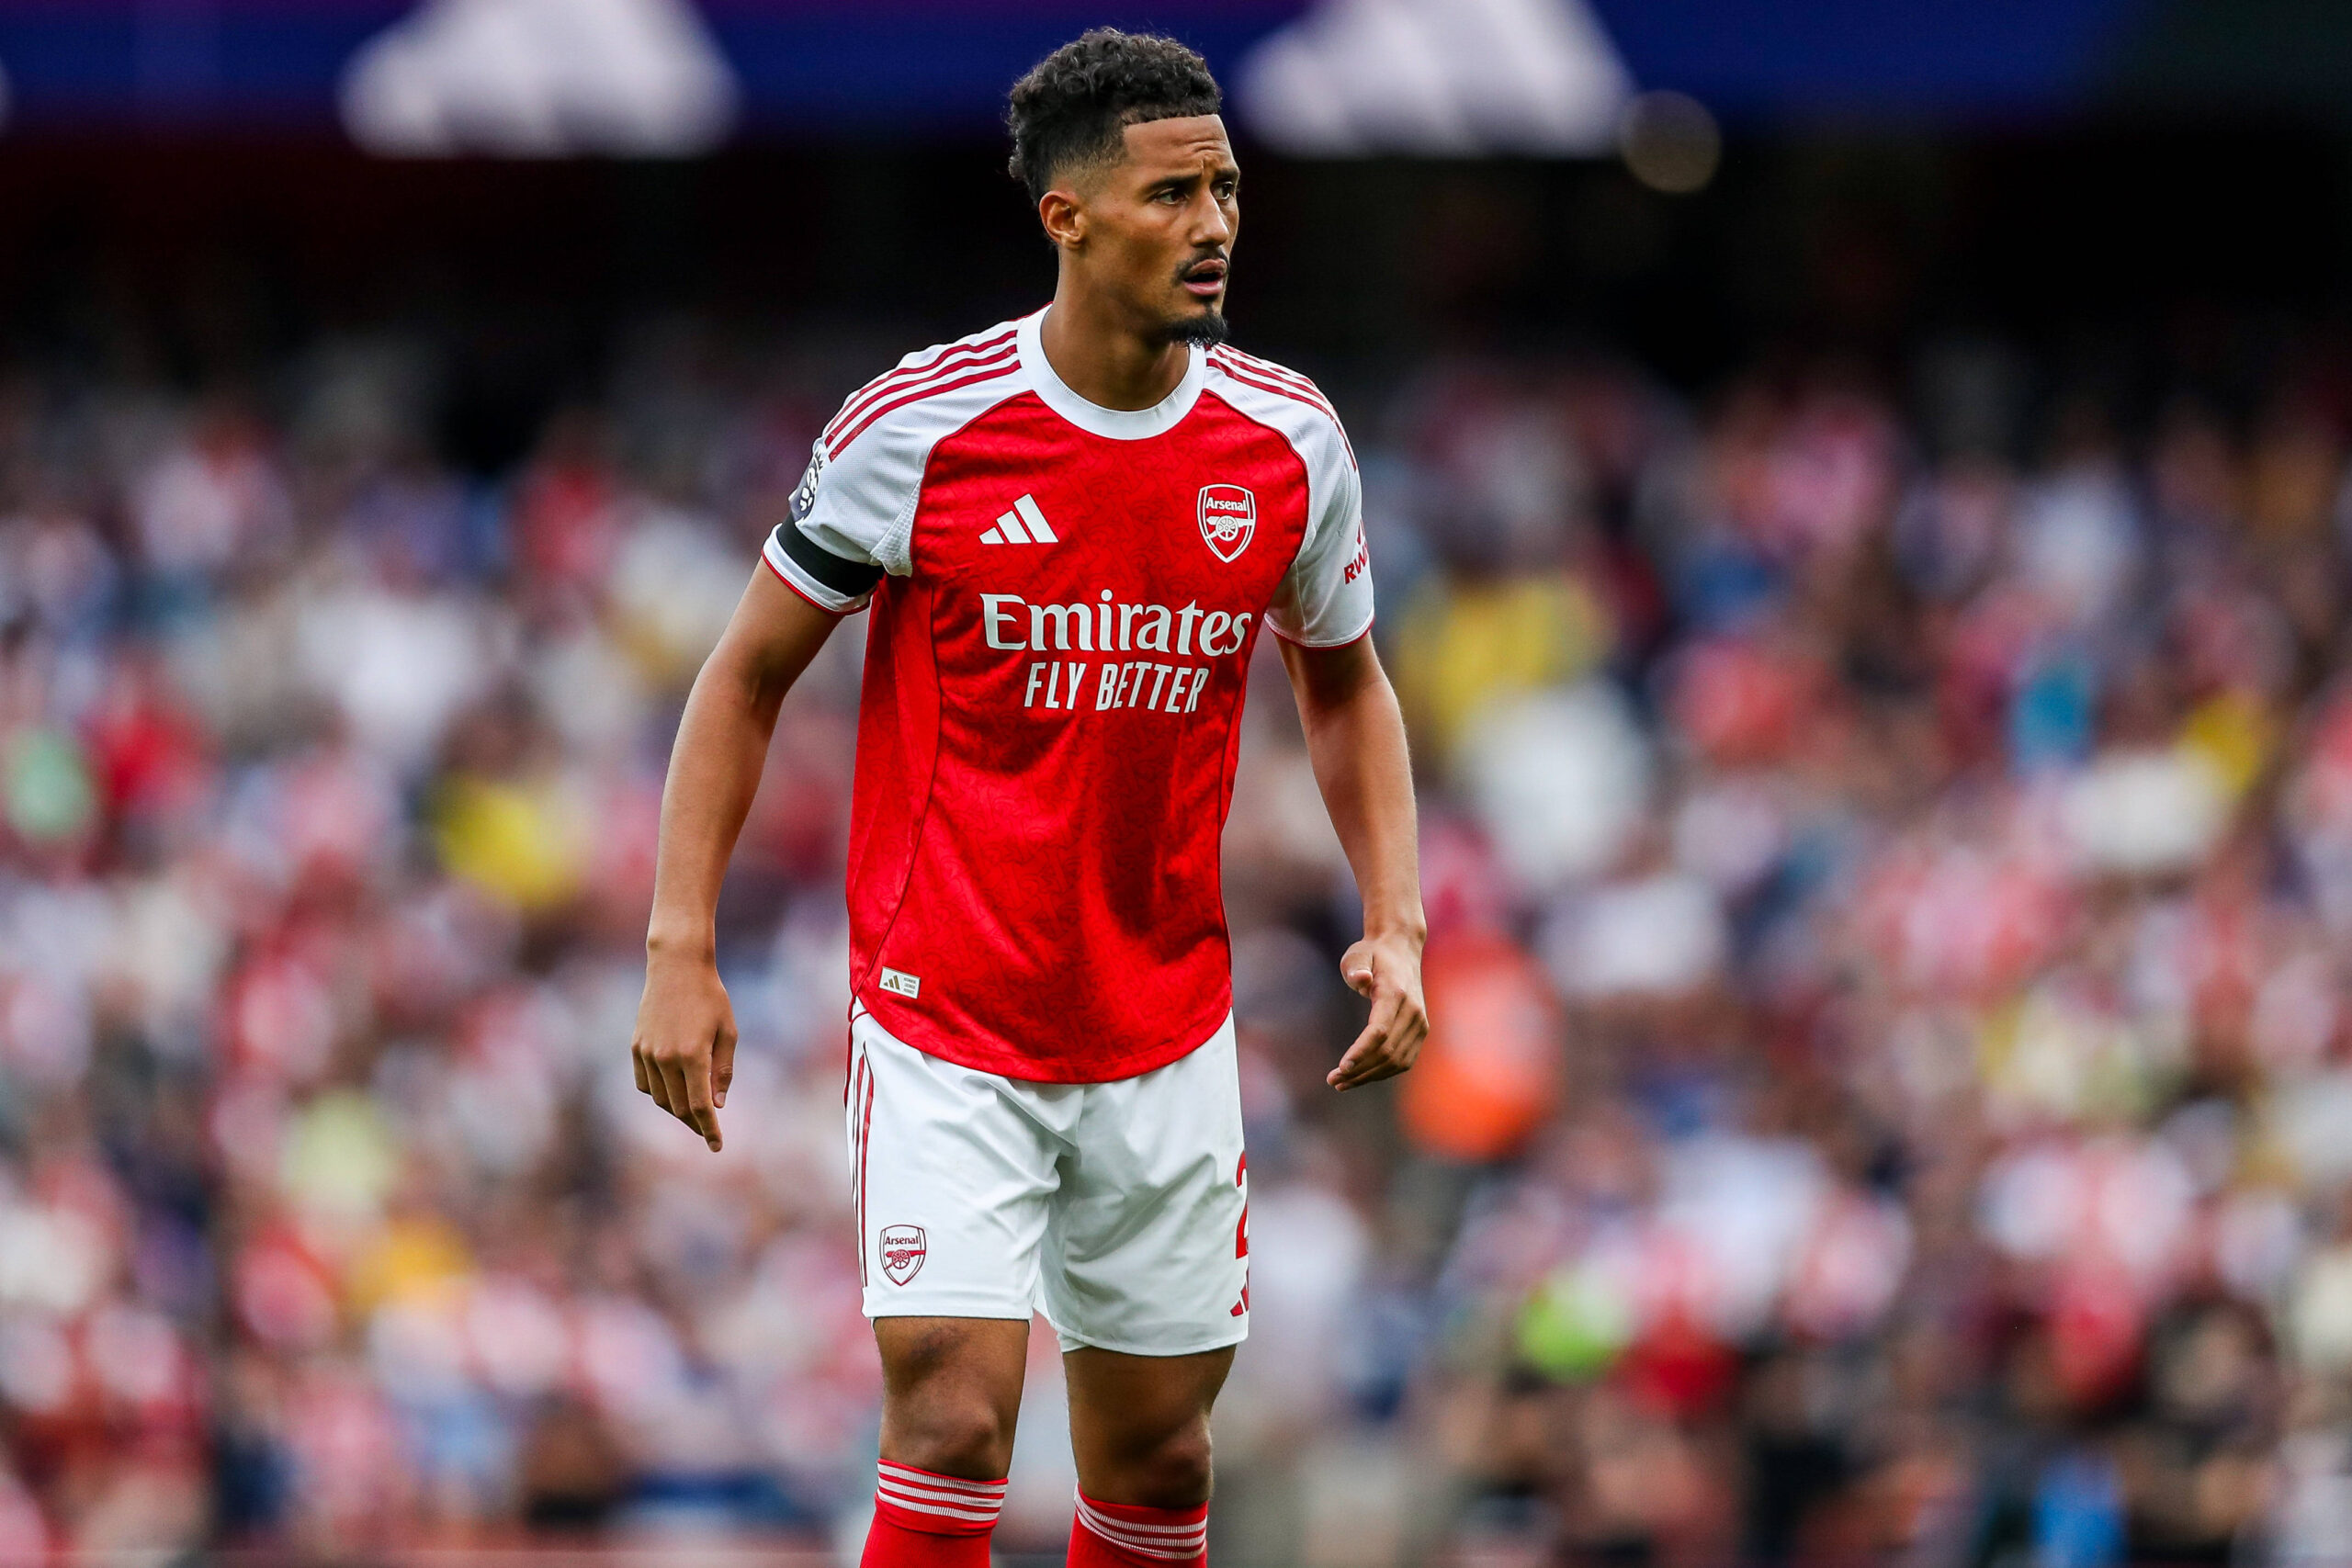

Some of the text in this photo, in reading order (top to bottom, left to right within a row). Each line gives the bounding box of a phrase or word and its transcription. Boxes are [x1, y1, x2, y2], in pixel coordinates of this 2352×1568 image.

[1205, 496, 1248, 512] Arsenal
[1343, 540, 1368, 585] RW
[978, 589, 1252, 657] Emirates
[1023, 660, 1209, 714] FLY BETTER
[885, 1235, 919, 1246] Arsenal
